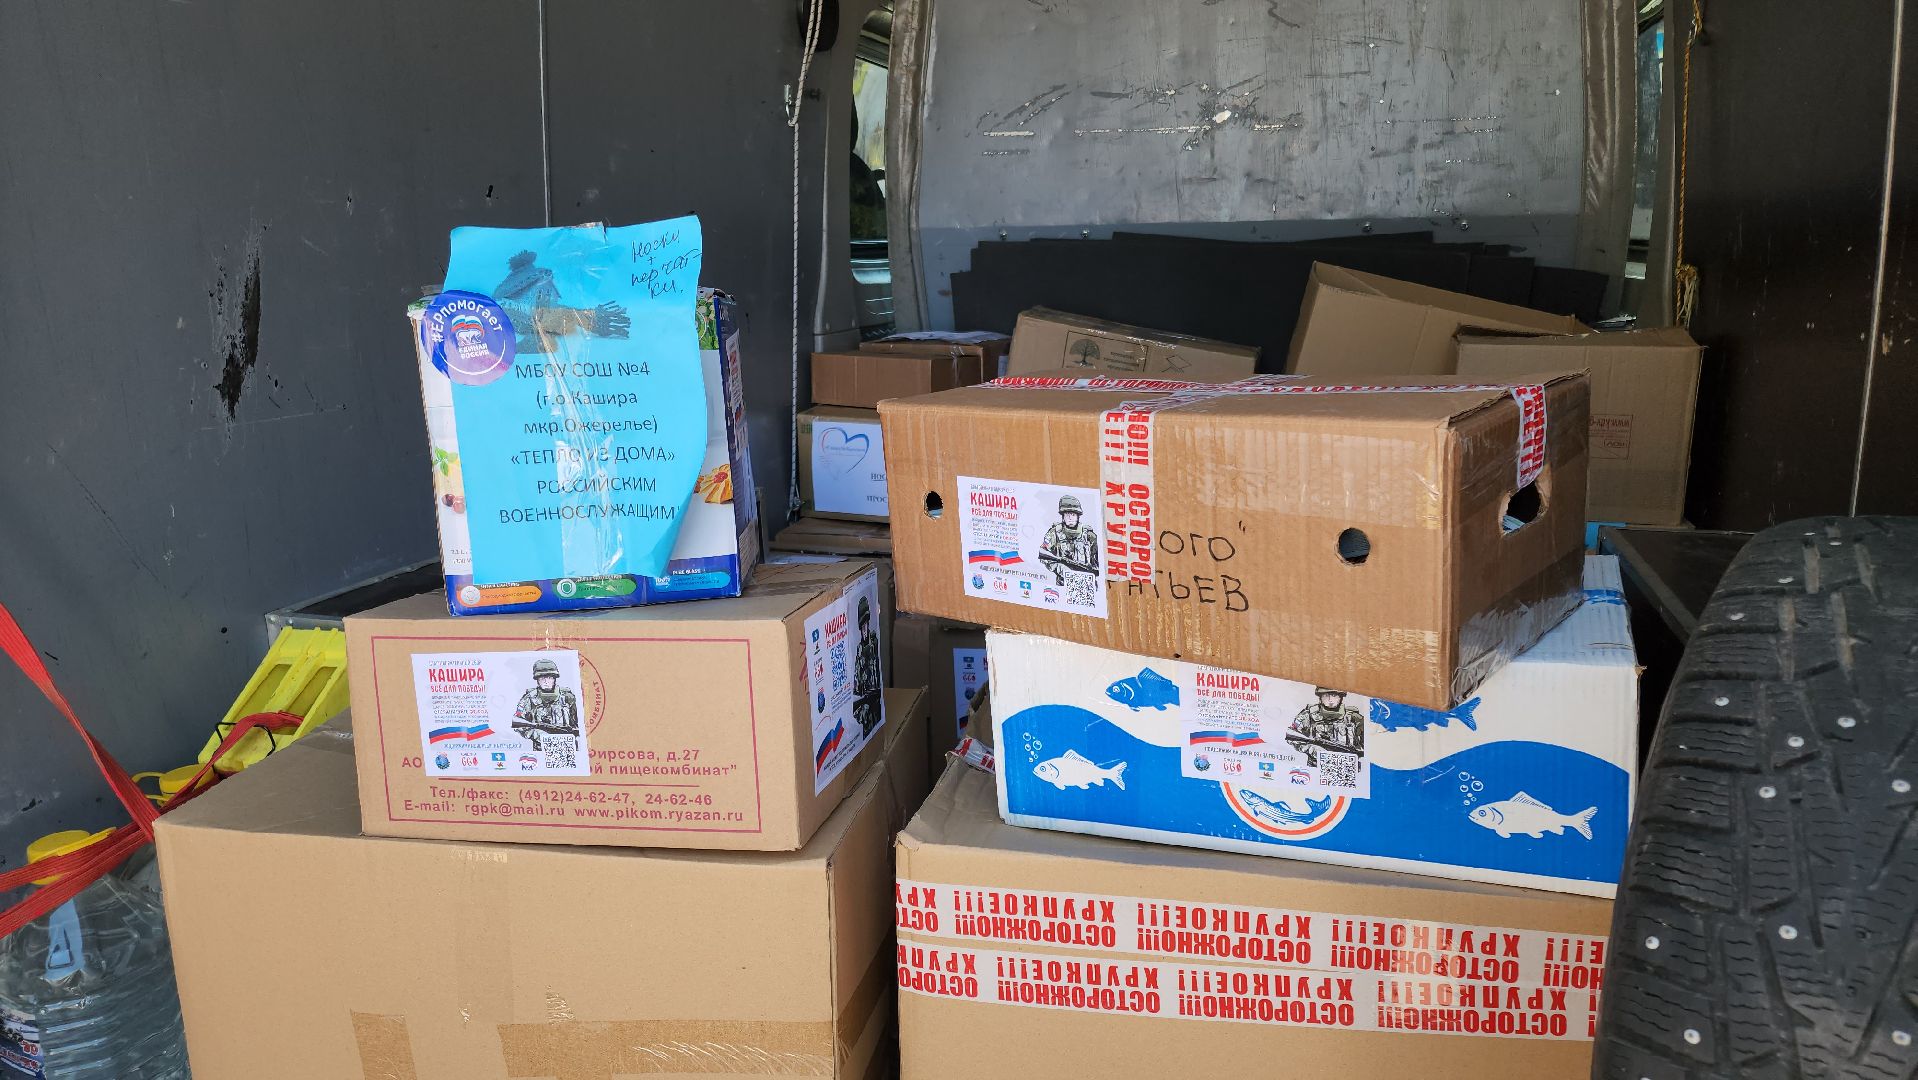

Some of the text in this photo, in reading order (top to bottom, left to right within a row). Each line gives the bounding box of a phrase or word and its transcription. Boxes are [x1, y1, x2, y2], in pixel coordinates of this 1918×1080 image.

[515, 361, 651, 379] МБОУ СОШ №4
[524, 415, 658, 436] мкр.Ожерелье)
[511, 449, 583, 465] «ТЕПЛО
[614, 446, 676, 464] ДОМА»
[537, 471, 657, 494] РОССИЙСКИМ
[970, 491, 1018, 511] КАШИРА
[1105, 480, 1128, 577] ХРУПК
[428, 667, 485, 682] КАШИРА
[1196, 672, 1260, 692] КАШИРА
[401, 756, 423, 768] АО
[666, 749, 700, 763] д.27
[404, 800, 744, 823] E-mail: rgpk@mail.ru www.pikom.ryazan.ru
[430, 785, 713, 806] Тел./факс: (4912)24-62-47, 24-62-46
[953, 889, 1116, 925] ХРУПКОЕ!!!
[1137, 902, 1312, 940] ХРУПКОЕ!!!
[954, 913, 1117, 949] ОСТОРОЖНО!!!
[1136, 927, 1312, 965] ОСТОРОЖНО!!!
[1331, 918, 1521, 959] ХРУПКОЕ!!!
[996, 956, 1160, 990] ХРУПКОЕ!!!
[1330, 941, 1520, 984] ОСТОРОЖНО!!!
[997, 979, 1161, 1014] ОСТОРОЖНО!!!
[1177, 968, 1354, 1002] ХРУПКОЕ!!!
[1377, 979, 1567, 1011] ХРУПКОЕ!!!
[1177, 993, 1355, 1026] ОСТОРОЖНО!!!
[1377, 1005, 1568, 1038] ОСТОРОЖНО!!!
